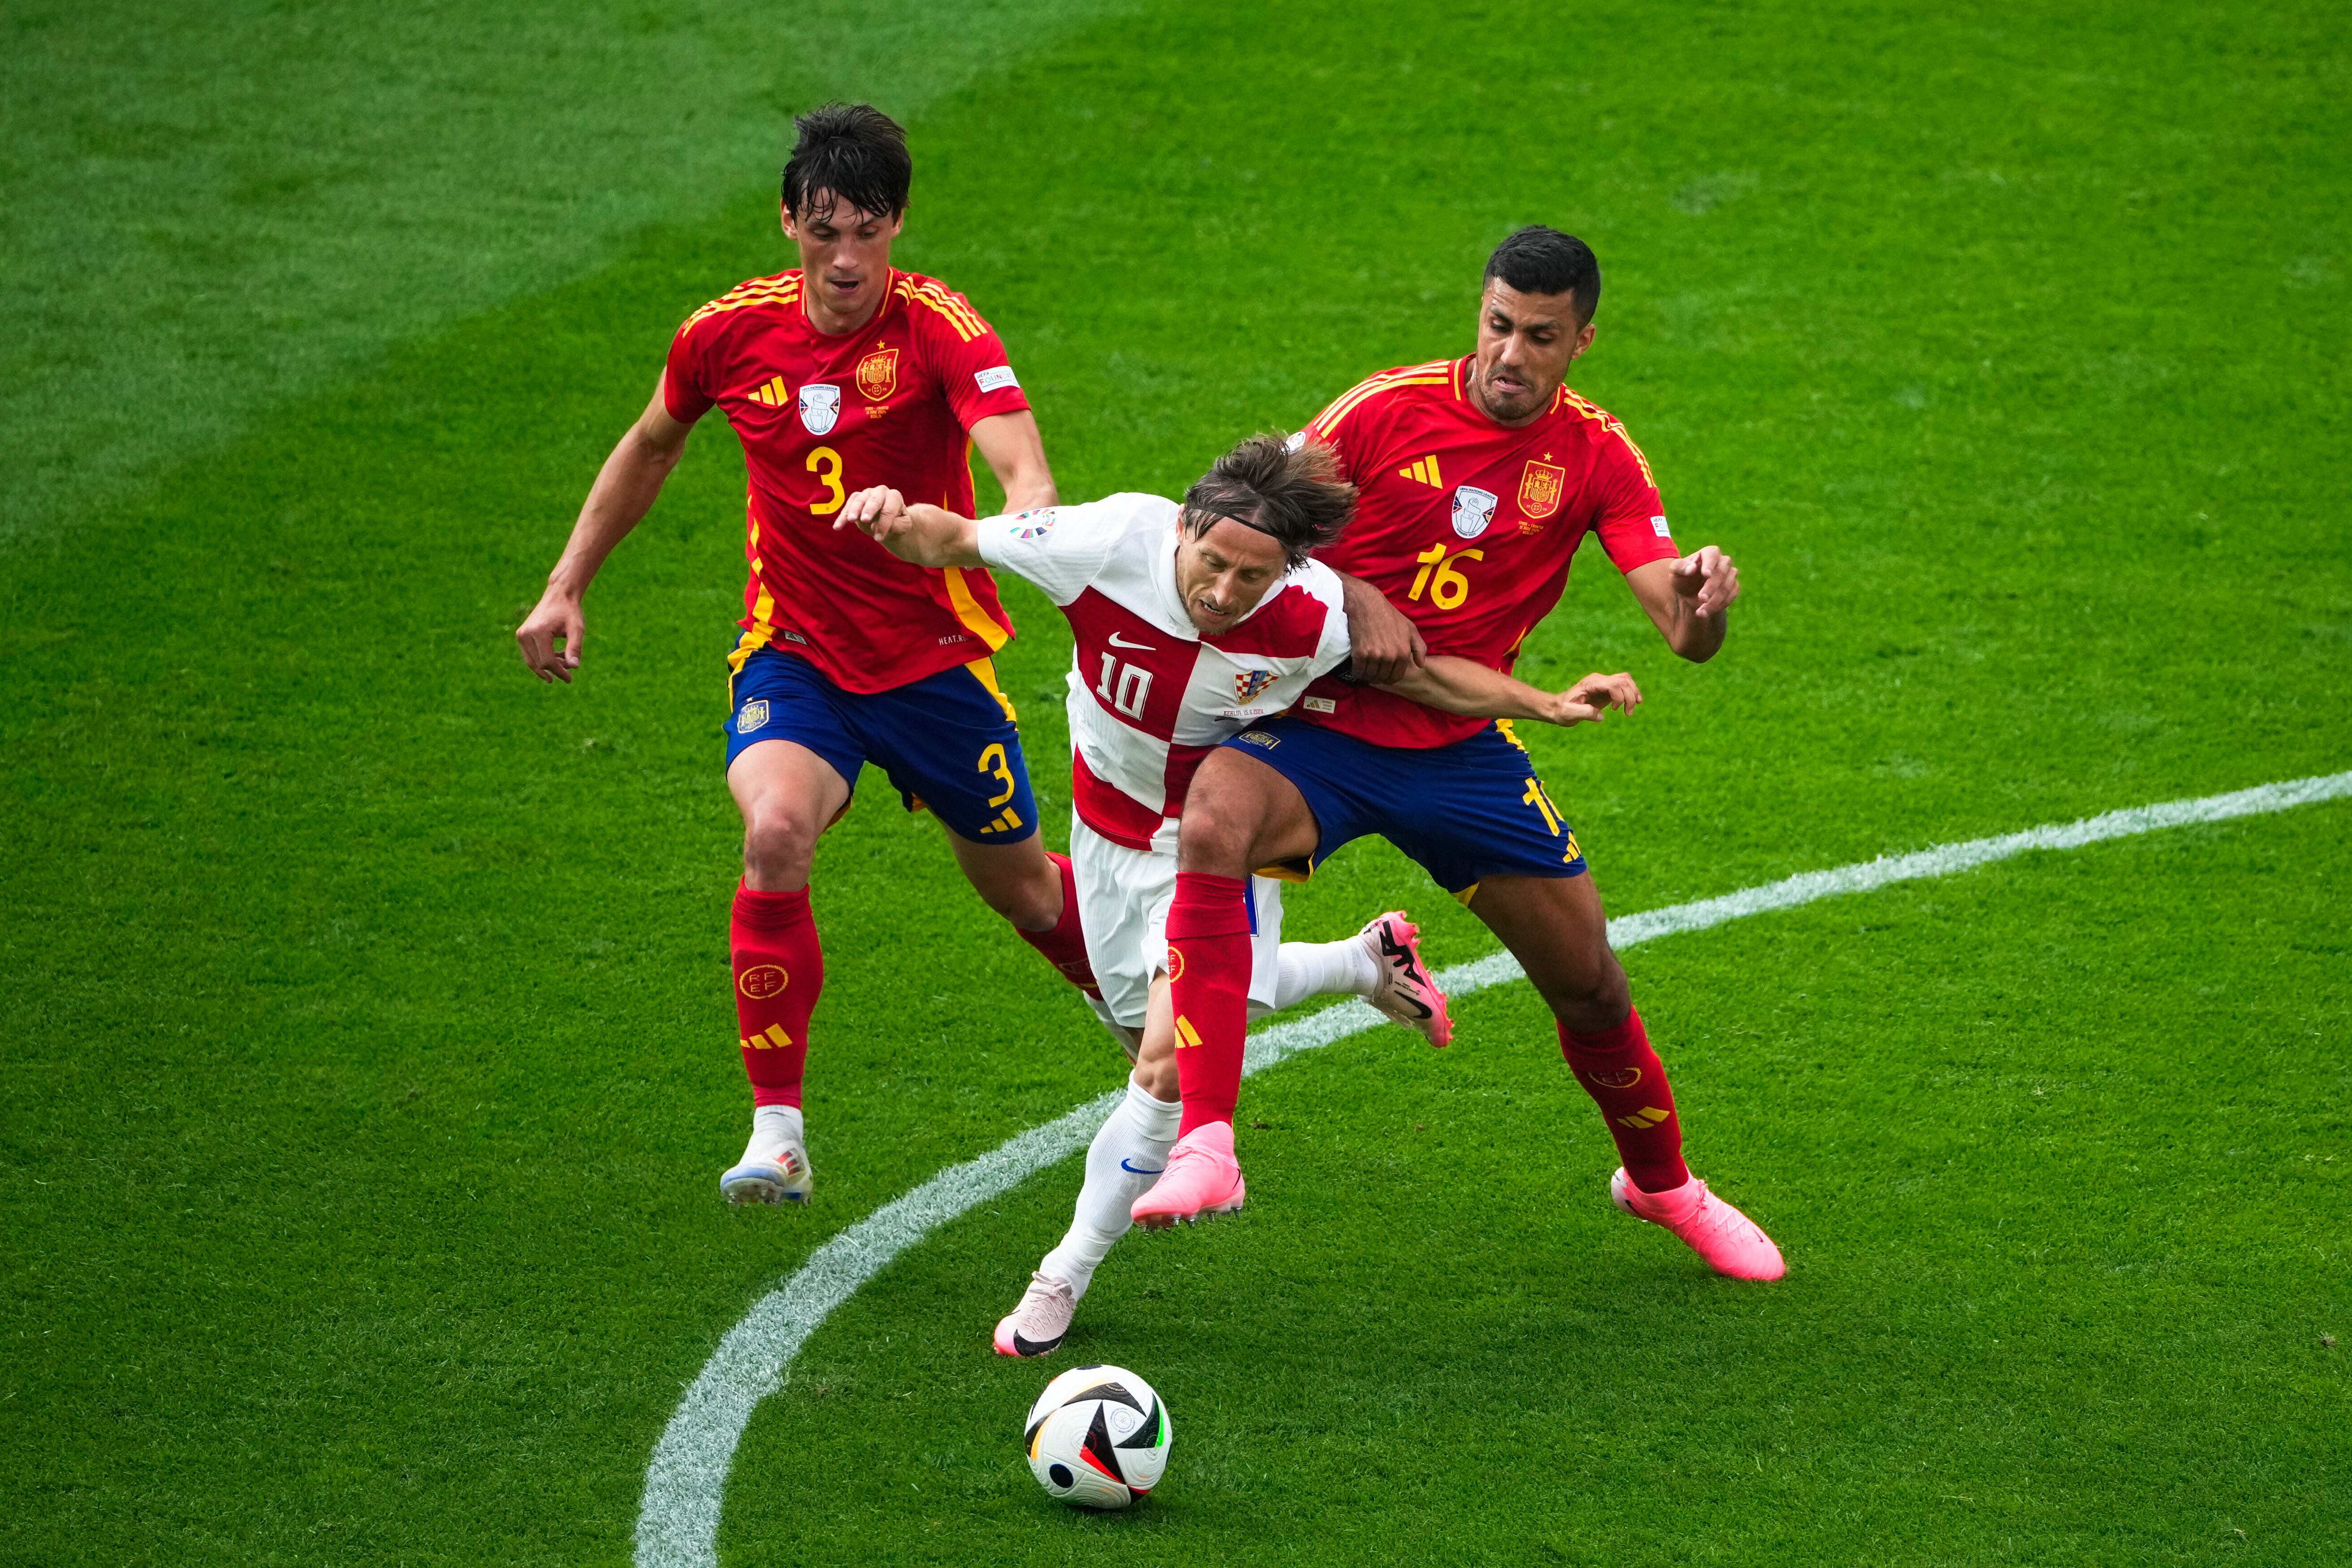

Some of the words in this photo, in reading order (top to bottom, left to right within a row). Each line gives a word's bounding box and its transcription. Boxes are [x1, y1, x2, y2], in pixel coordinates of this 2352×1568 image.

[806, 446, 845, 515] 3
[1408, 542, 1484, 610] 16
[1096, 651, 1153, 721] 10
[977, 743, 1015, 808] 3
